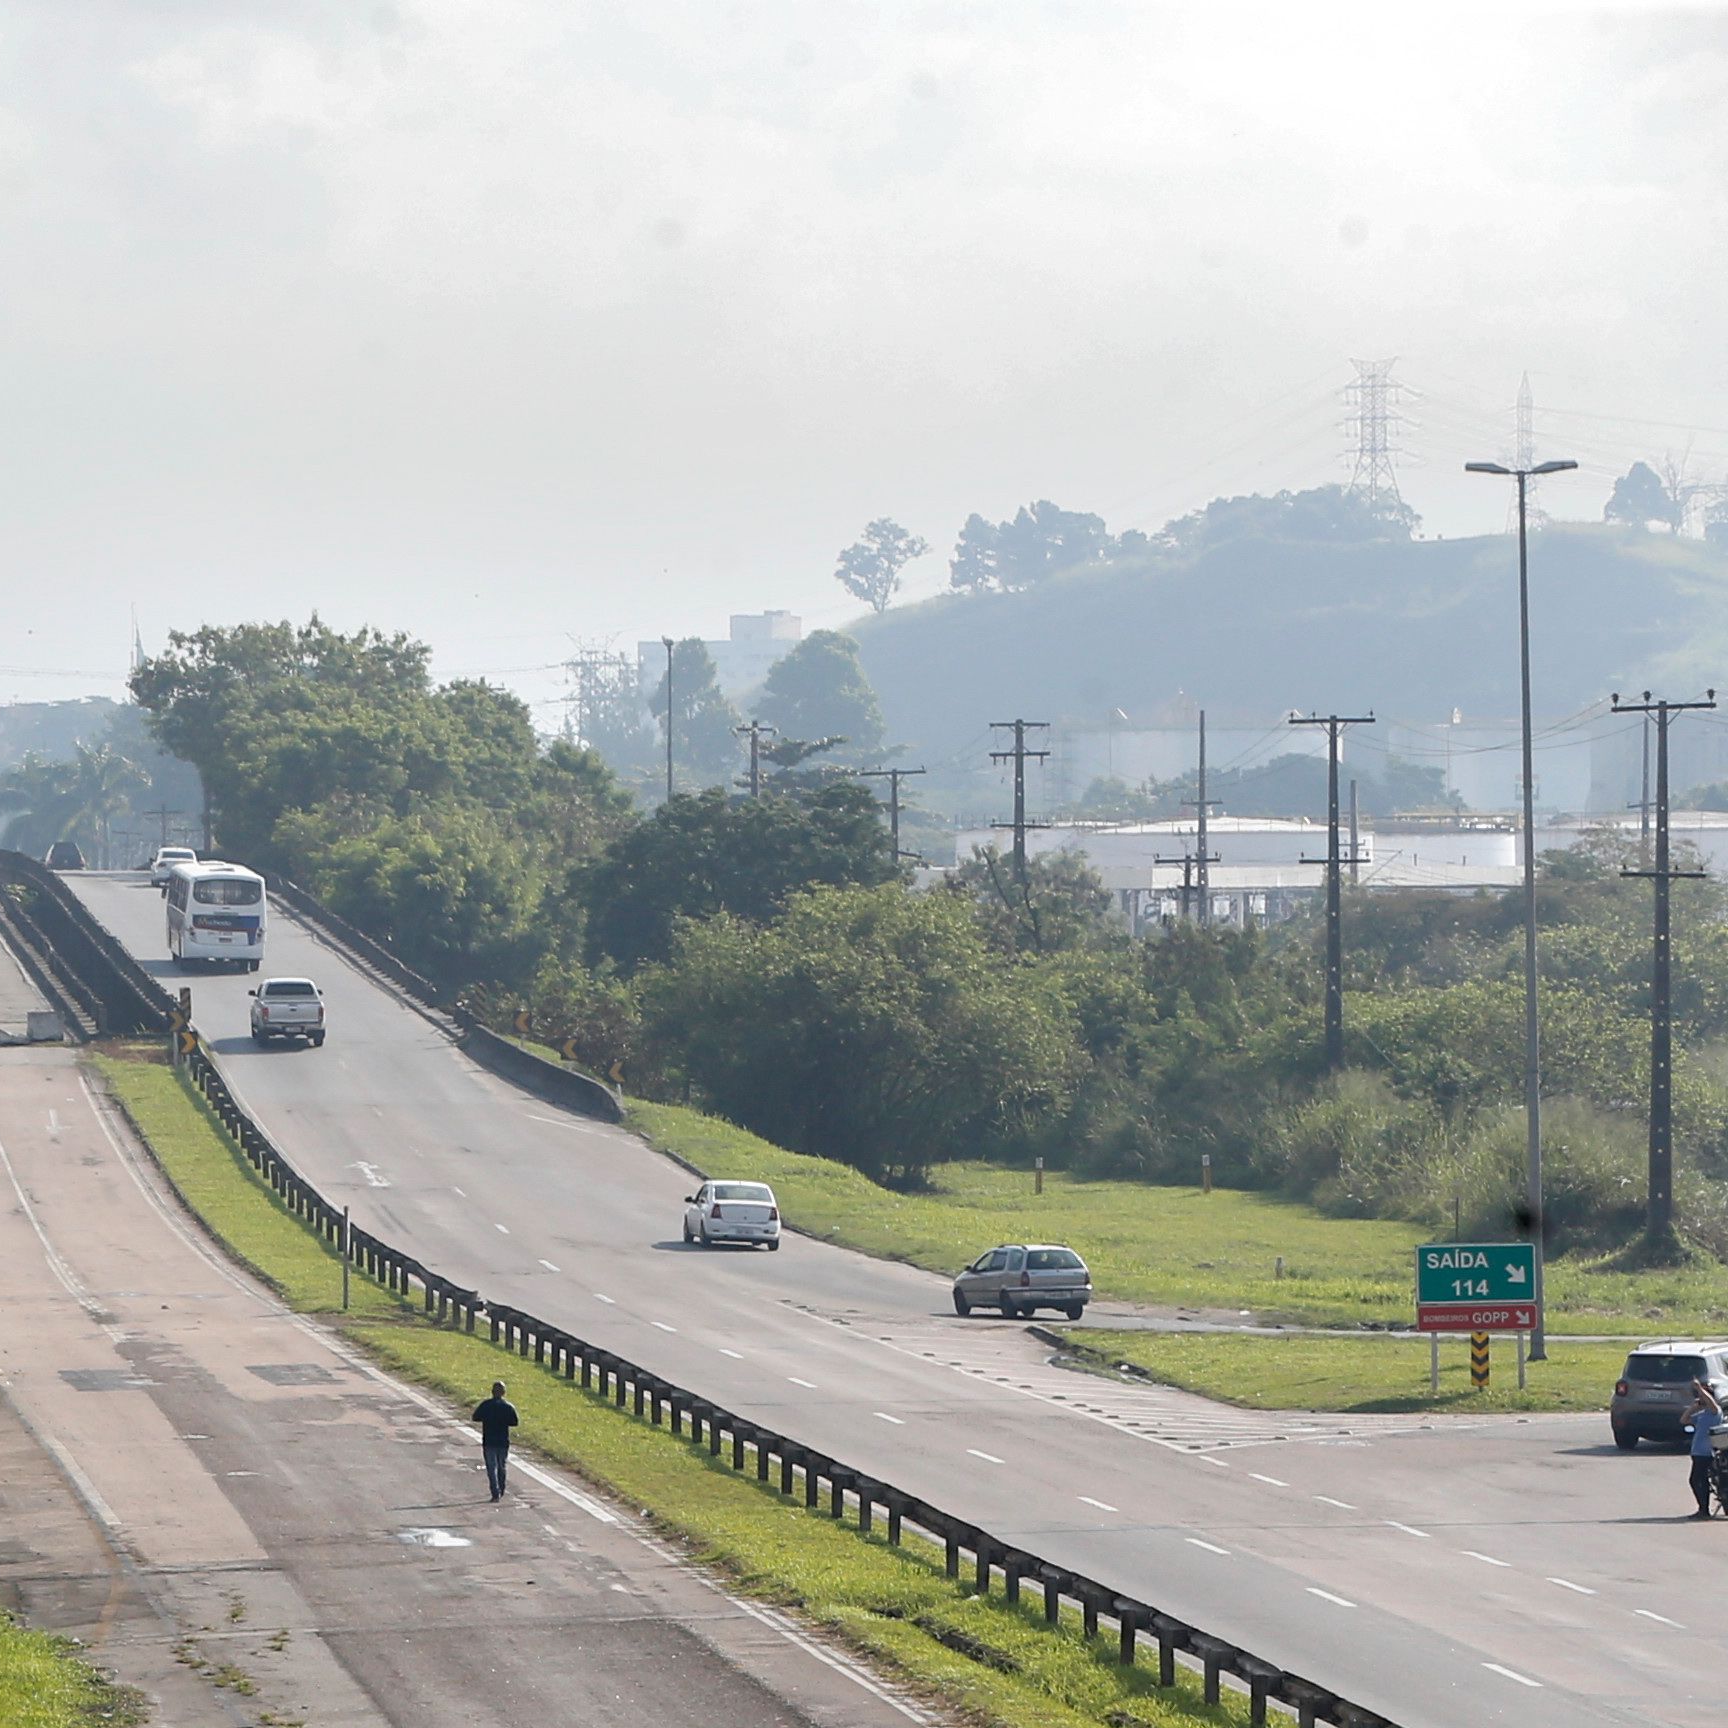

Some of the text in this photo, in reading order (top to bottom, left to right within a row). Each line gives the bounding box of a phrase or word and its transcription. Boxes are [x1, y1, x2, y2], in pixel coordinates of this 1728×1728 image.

[1426, 1249, 1489, 1269] SAÍDA
[1451, 1280, 1489, 1296] 114
[1472, 1311, 1509, 1323] GOPP
